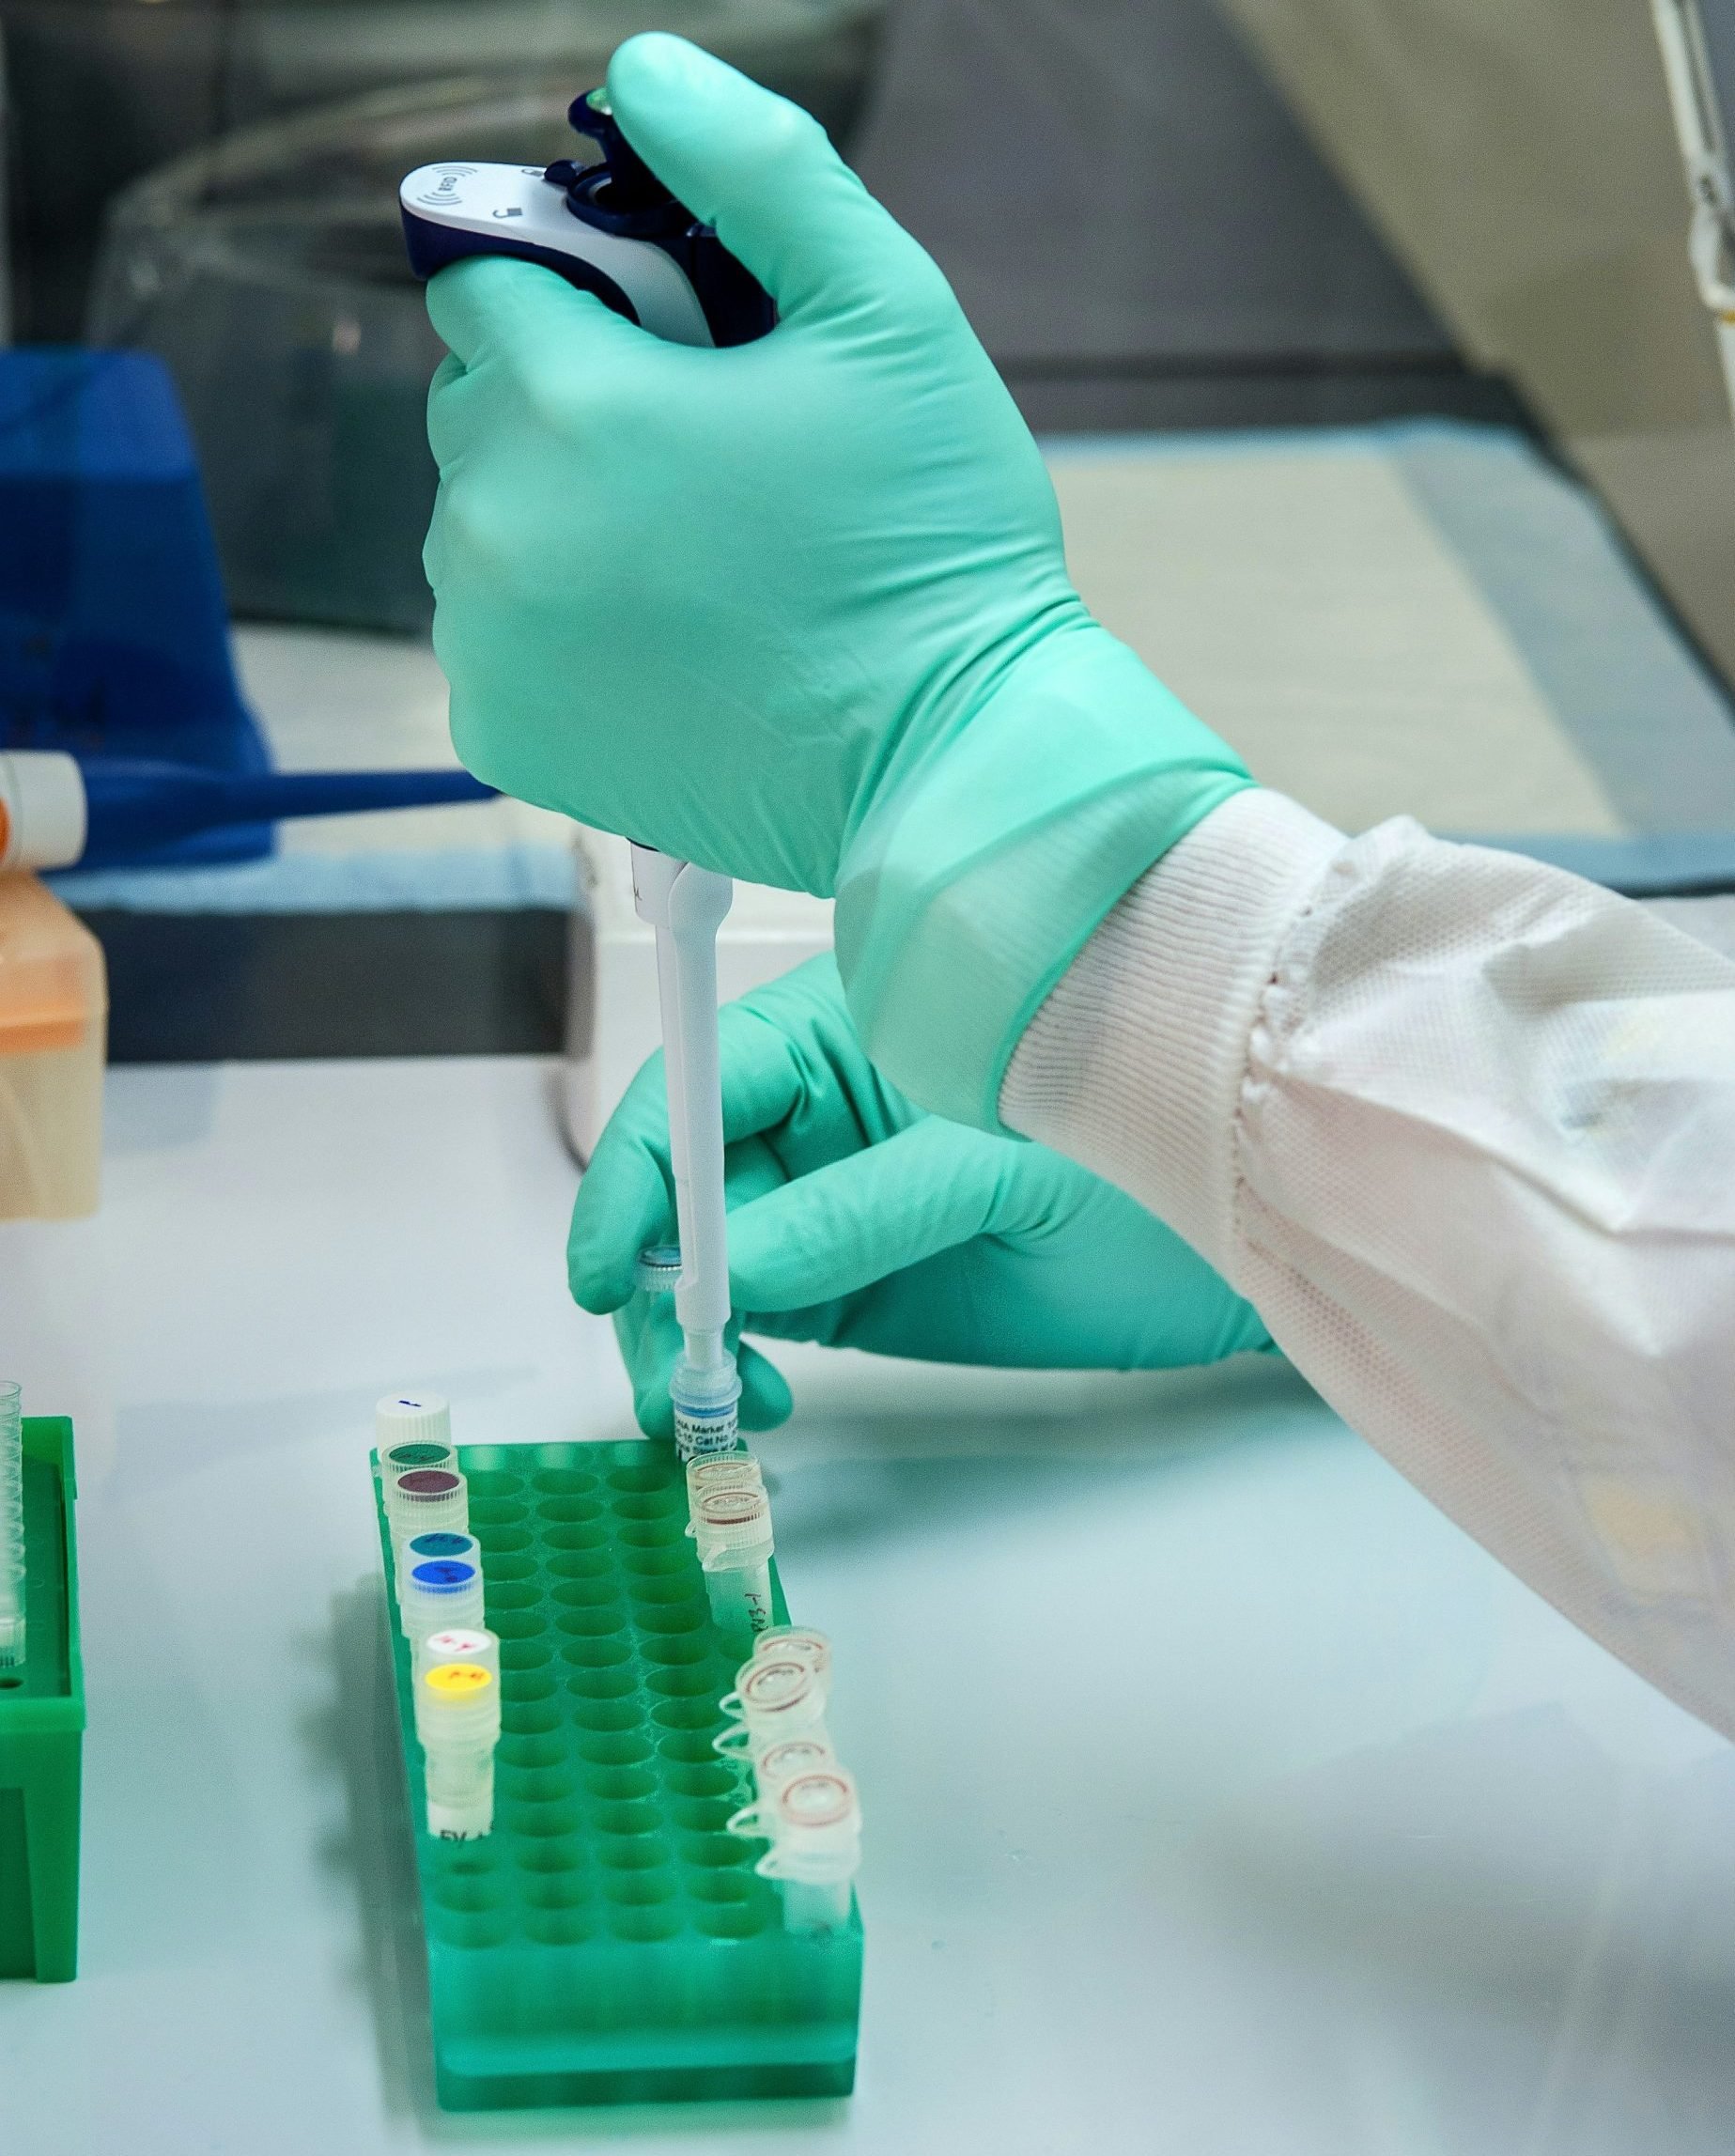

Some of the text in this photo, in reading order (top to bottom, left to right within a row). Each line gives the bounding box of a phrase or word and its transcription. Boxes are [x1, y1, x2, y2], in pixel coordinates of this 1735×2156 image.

[438, 176, 457, 191] RFID
[692, 1424, 724, 1435] Marker
[695, 1435, 713, 1446] Cat
